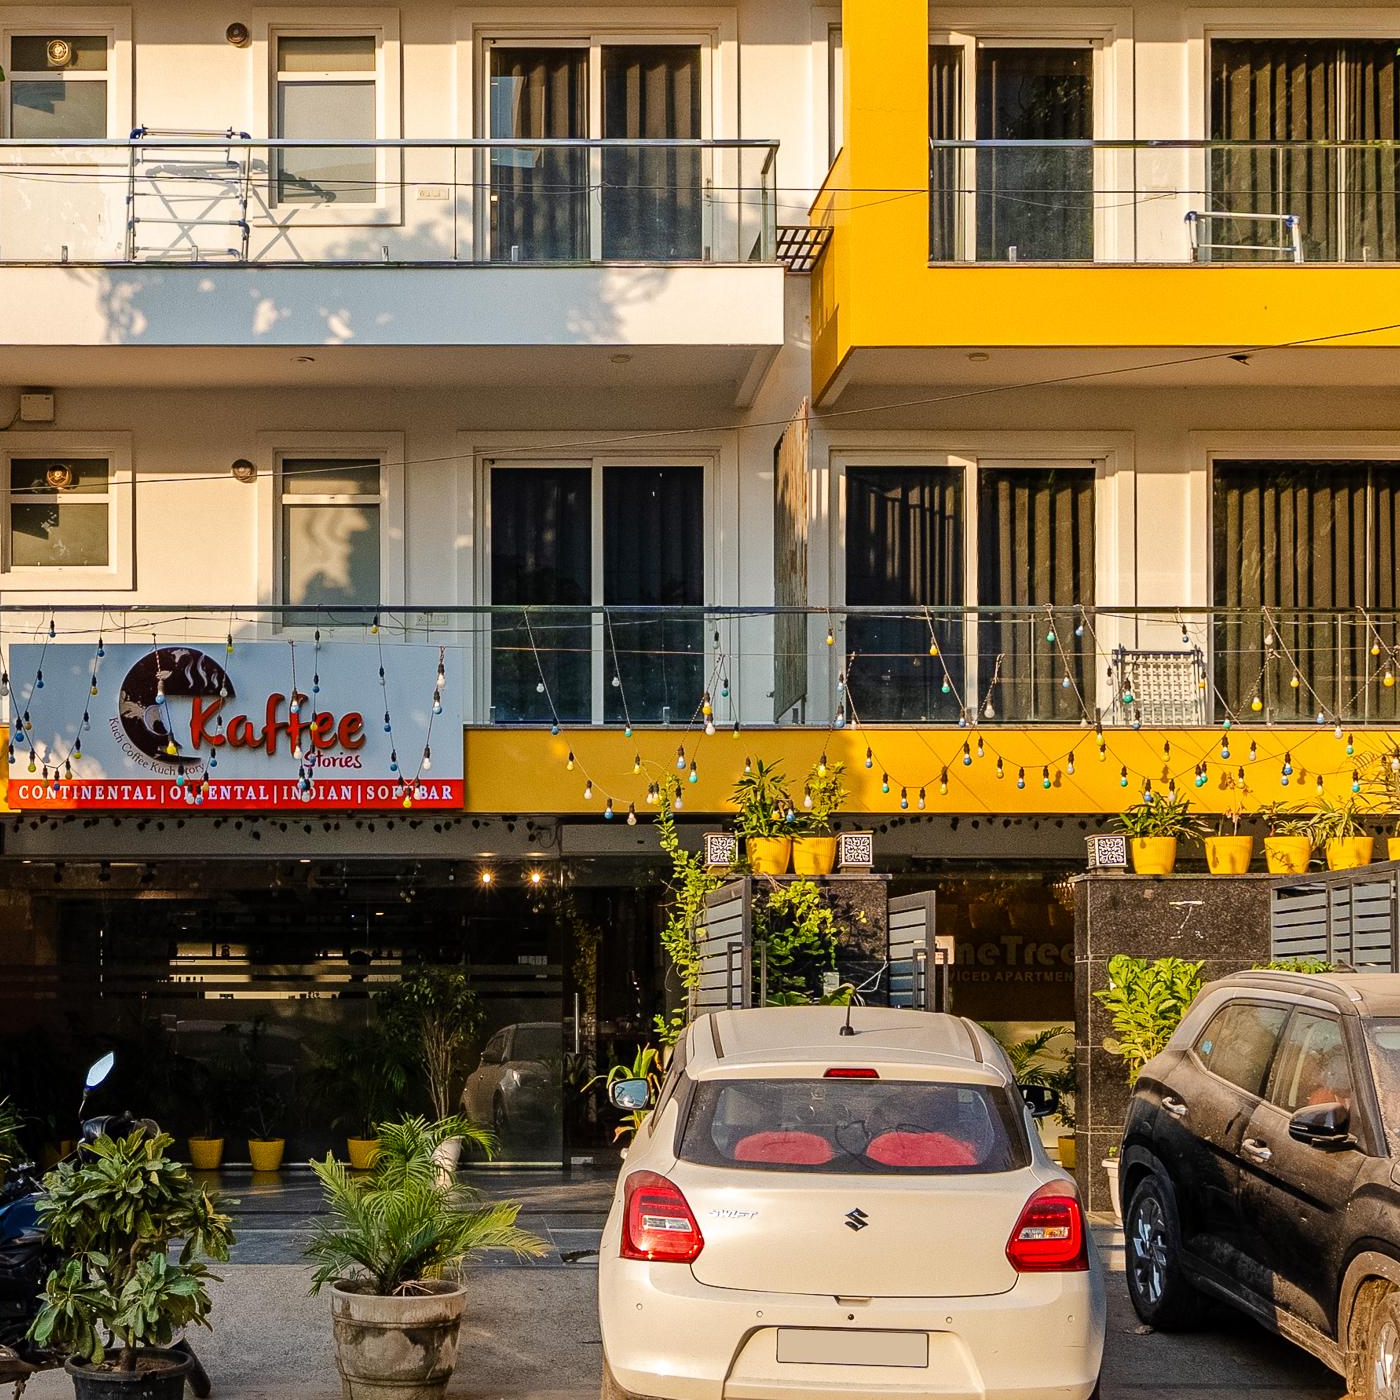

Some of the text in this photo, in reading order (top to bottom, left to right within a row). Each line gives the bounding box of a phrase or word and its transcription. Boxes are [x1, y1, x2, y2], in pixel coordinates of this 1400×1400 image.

[190, 693, 366, 757] Kaffee
[109, 717, 205, 776] Kuch Coffee Kuch tory
[304, 750, 362, 768] Stories
[18, 785, 156, 800] CONTINENTAL
